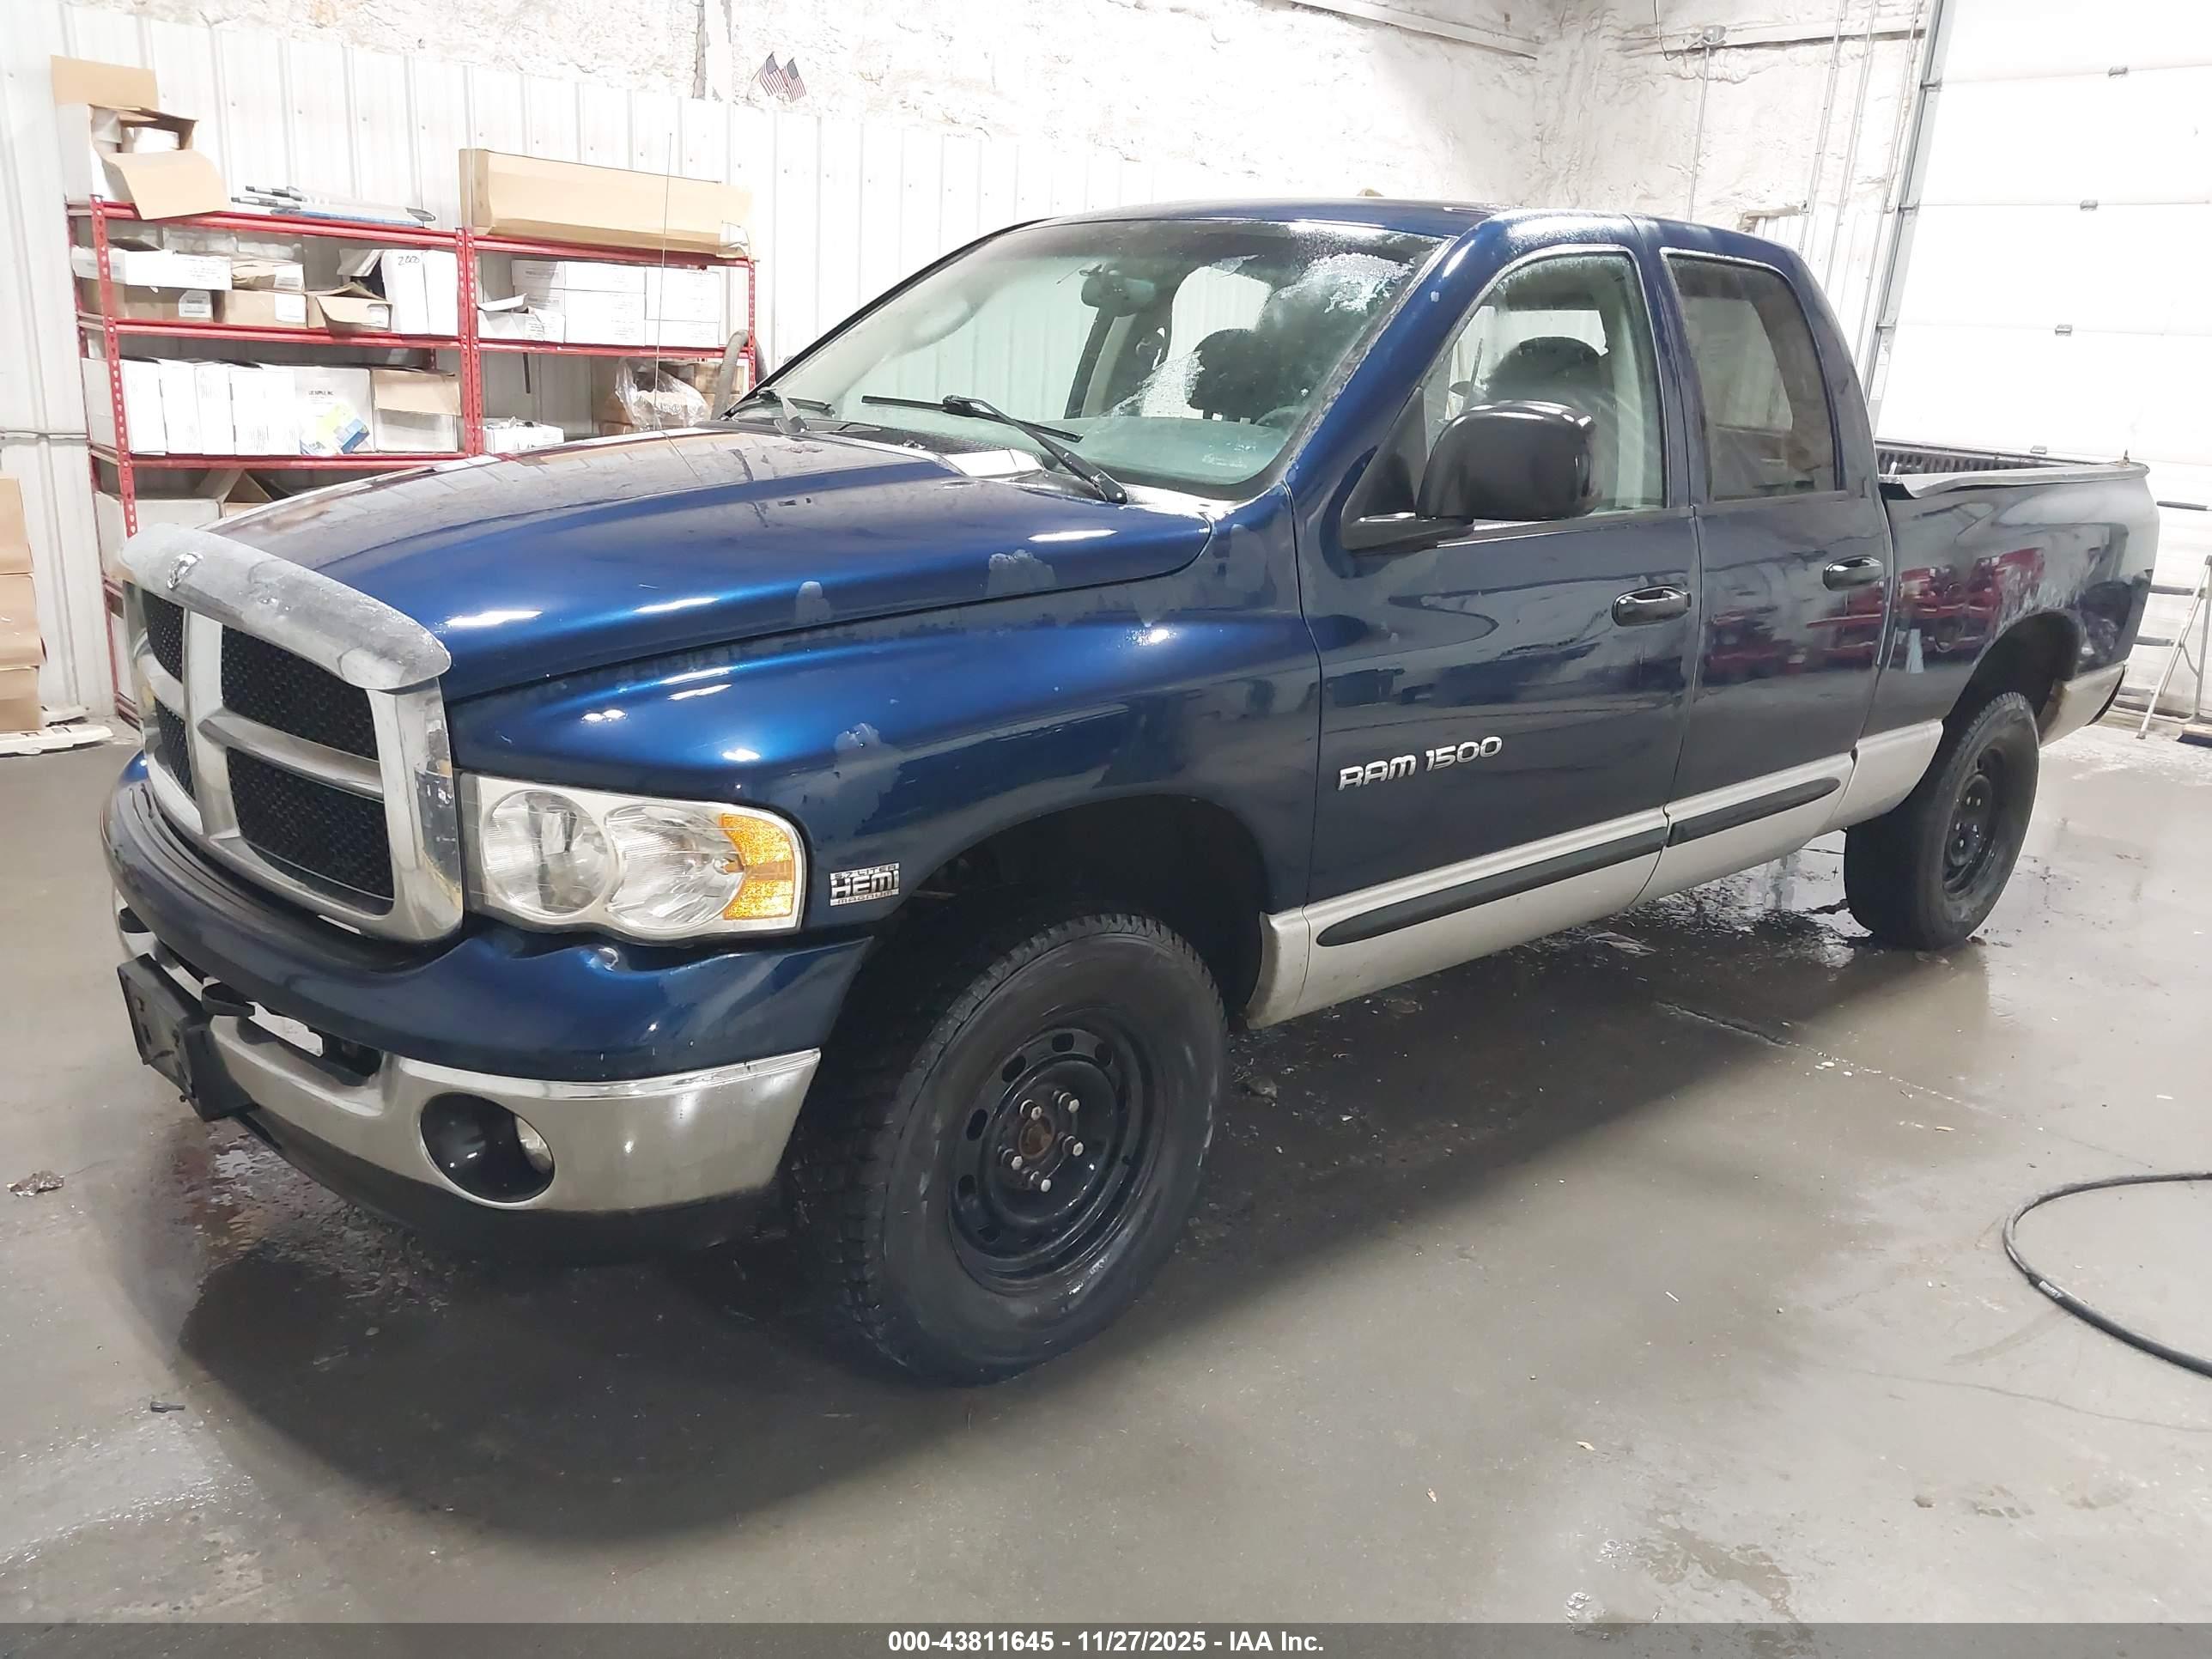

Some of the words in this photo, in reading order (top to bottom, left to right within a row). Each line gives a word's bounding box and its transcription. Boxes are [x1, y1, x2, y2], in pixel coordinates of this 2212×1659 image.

[1338, 755, 1417, 791] RAM
[1426, 736, 1503, 771] 1500
[830, 870, 900, 899] HEMI
[837, 890, 894, 904] MAGNUM
